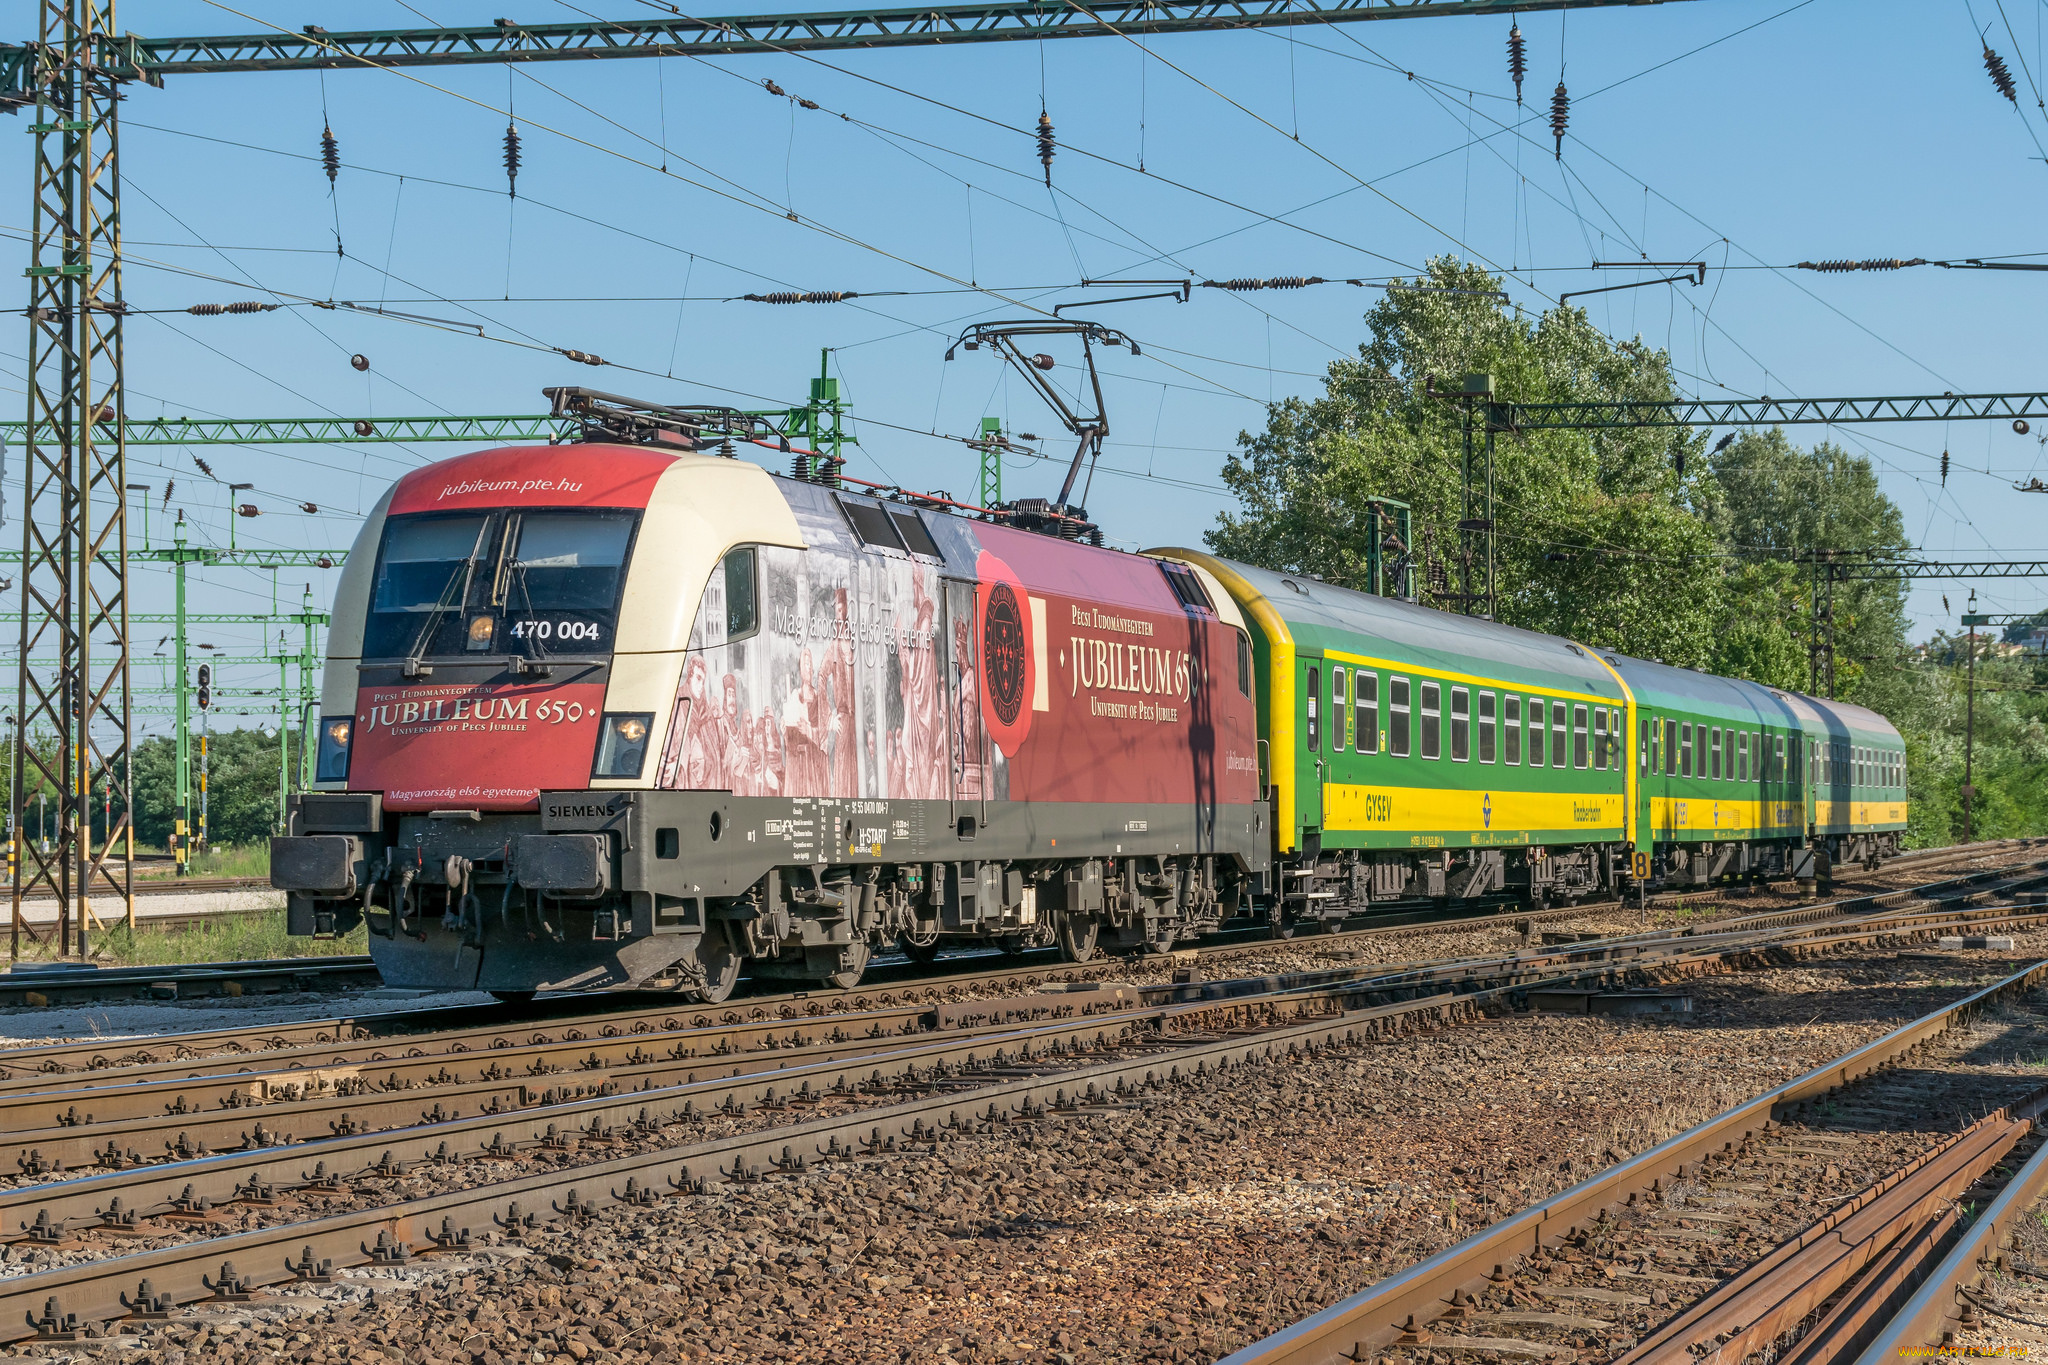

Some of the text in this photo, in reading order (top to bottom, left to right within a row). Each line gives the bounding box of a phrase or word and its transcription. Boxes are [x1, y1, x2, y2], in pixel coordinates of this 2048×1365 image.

[437, 477, 583, 501] jubileum.pte.hu
[510, 621, 599, 640] 470 004
[774, 604, 856, 650] Magyarország
[859, 616, 880, 644] első
[1070, 636, 1199, 703] JUBILEUM 650
[367, 698, 583, 733] JUBILEUM 650
[1090, 695, 1128, 719] UNIVERSITY
[1130, 704, 1138, 719] OF
[1155, 702, 1178, 725] JUBILEE
[391, 725, 444, 736] UNIVERSITY
[489, 722, 527, 733] JUBILEE
[390, 787, 456, 801] Magyarország
[459, 786, 480, 797] első
[549, 805, 615, 817] SIEMENS
[1366, 794, 1392, 821] GYSEV
[859, 827, 887, 845] H-START
[1634, 853, 1647, 877] 8
